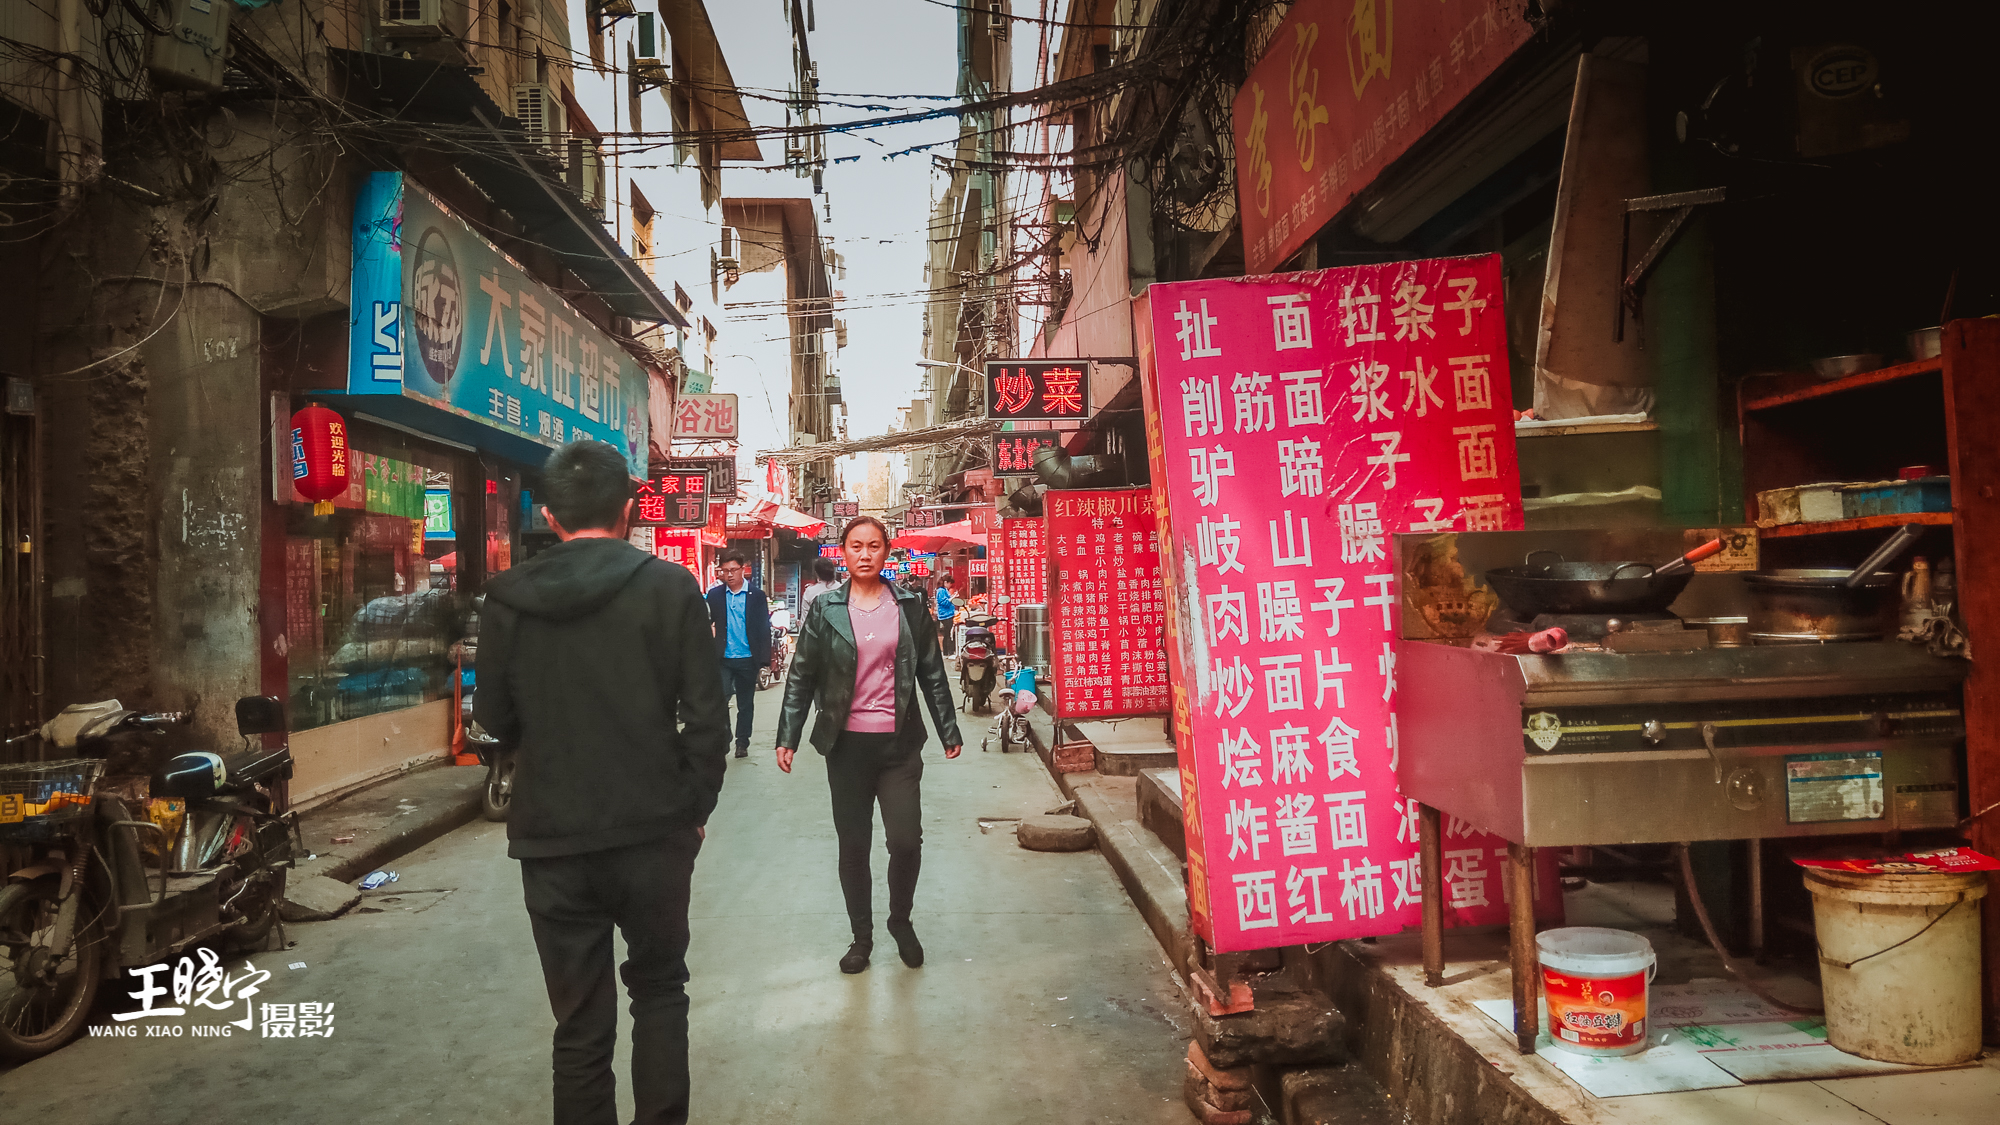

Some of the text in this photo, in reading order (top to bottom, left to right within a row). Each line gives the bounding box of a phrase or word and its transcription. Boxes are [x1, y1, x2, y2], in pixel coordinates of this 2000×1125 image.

[1818, 65, 1867, 86] CEP
[1292, 184, 1317, 231] 拉条子
[1449, 0, 1514, 76] 手工水
[1174, 276, 1488, 361] 扯面 拉条子
[479, 266, 621, 432] 大家旺超市
[994, 367, 1082, 414] 炒菜
[1180, 354, 1494, 437] 削筋面 浆水面
[538, 409, 565, 442] 烟酒
[328, 422, 346, 477] 欢迎光临
[637, 475, 704, 494] 大家旺
[638, 494, 703, 522] 超市
[1054, 495, 1154, 518] 红辣椒川菜
[1012, 520, 1045, 529] 正宗
[1091, 516, 1124, 530] 特色
[1057, 533, 1105, 544] 大盘鸡
[1058, 545, 1105, 557] 毛血旺
[1095, 556, 1124, 567] 小炒
[1060, 569, 1107, 580] 回锅肉
[1060, 578, 1162, 592] 水煮肉片 鱼香肉丝
[1061, 589, 1163, 604] 火爆猪肝 红烧排骨
[1061, 613, 1164, 628] 红烧带鱼 锅巴肉片
[1062, 625, 1163, 640] 宫保鸡丁 小炒肉
[1063, 652, 1111, 664] 青椒肉丝
[1064, 661, 1167, 676] 豆角茄子 手撕包菜
[1065, 676, 1112, 688] 西红柿鸡蛋
[1211, 647, 1353, 719] 炒面片
[1065, 688, 1113, 700] 土豆丝
[1066, 700, 1113, 712] 家常豆腐
[1217, 716, 1362, 790] 烩麻食
[1174, 681, 1209, 921] 李家面
[1224, 790, 1369, 862] 炸酱面
[1565, 1011, 1623, 1038] 红油豆瓣
